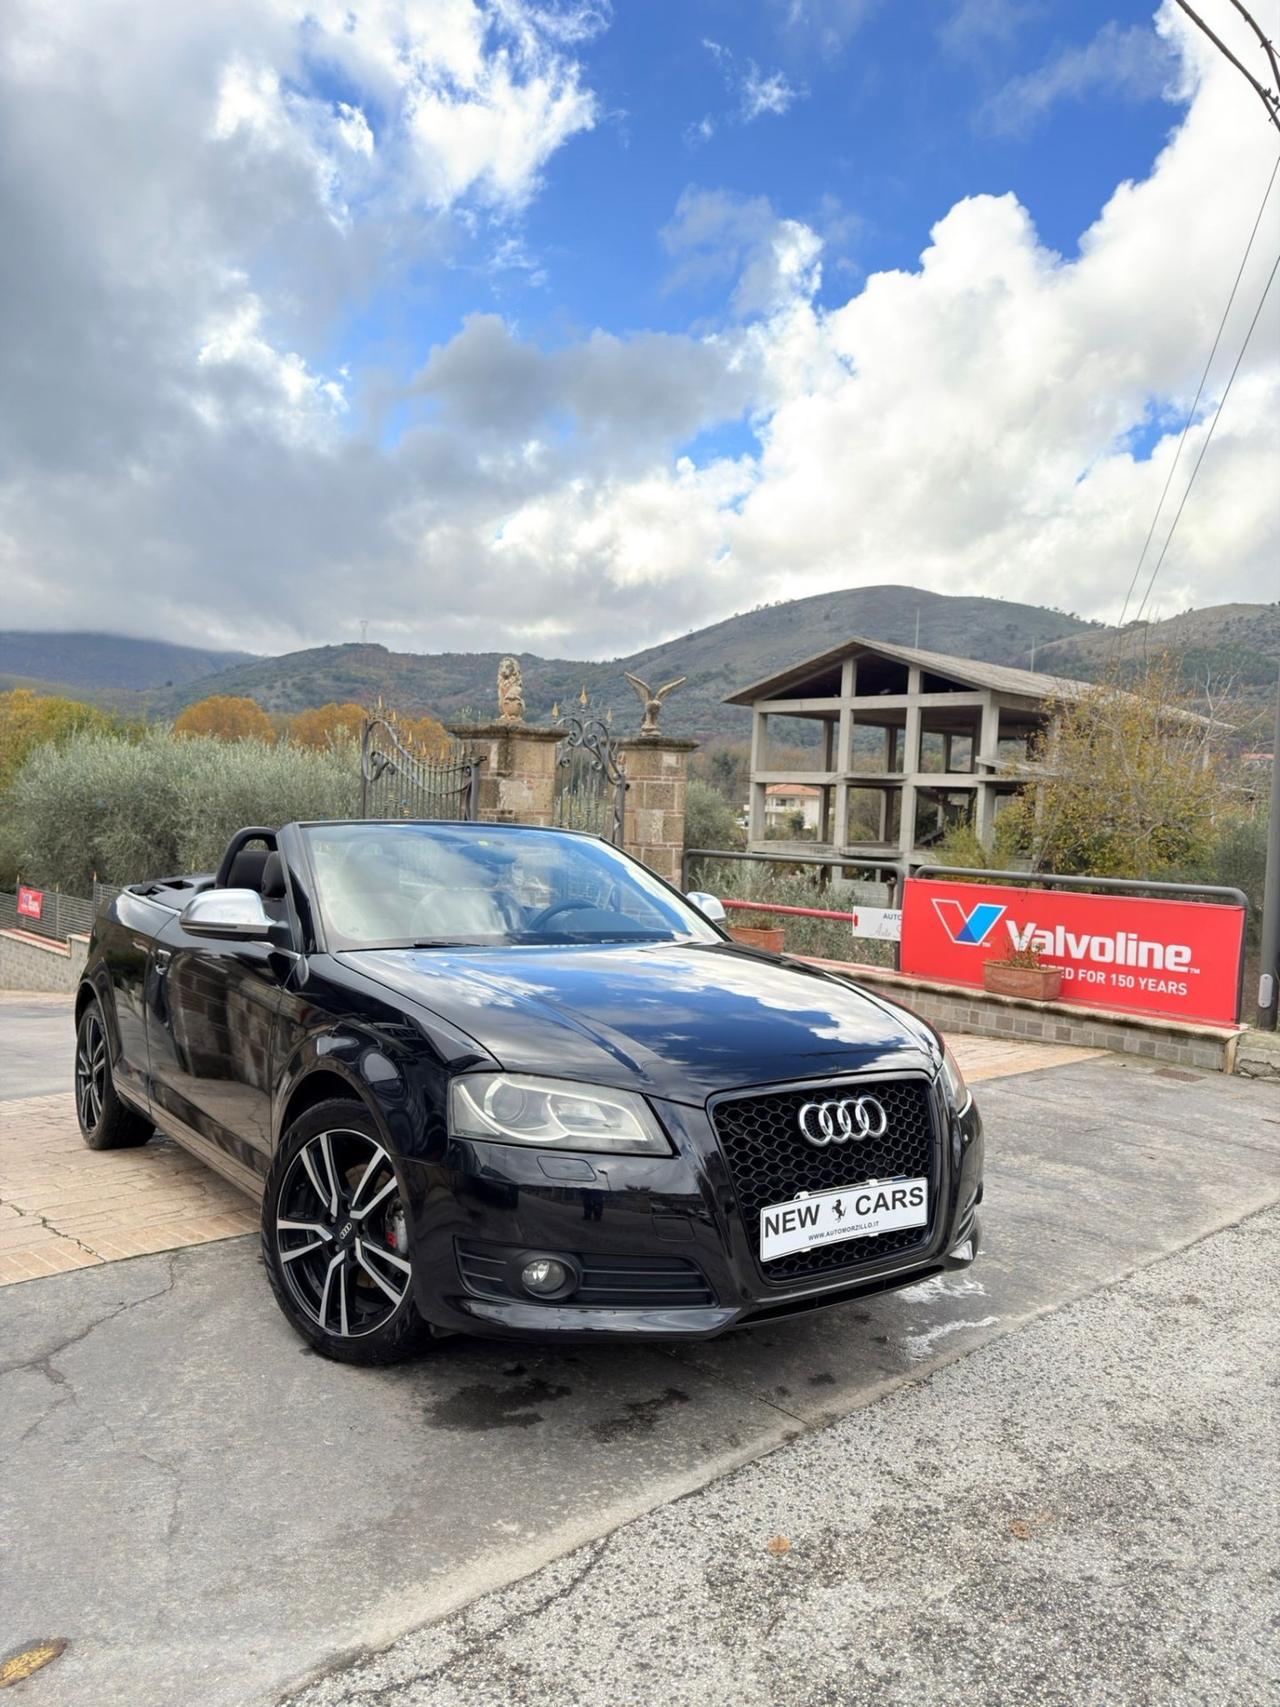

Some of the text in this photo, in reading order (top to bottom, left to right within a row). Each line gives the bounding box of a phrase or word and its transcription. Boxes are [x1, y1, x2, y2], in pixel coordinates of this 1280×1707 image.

[1005, 920, 1192, 973] Valvoline
[1078, 969, 1106, 985] FOR
[1110, 973, 1135, 989] 150
[1138, 977, 1188, 996] YEARS
[764, 1186, 924, 1238] NEW CARS
[808, 1221, 880, 1241] WWW.AUTOMORZILLO.IT
